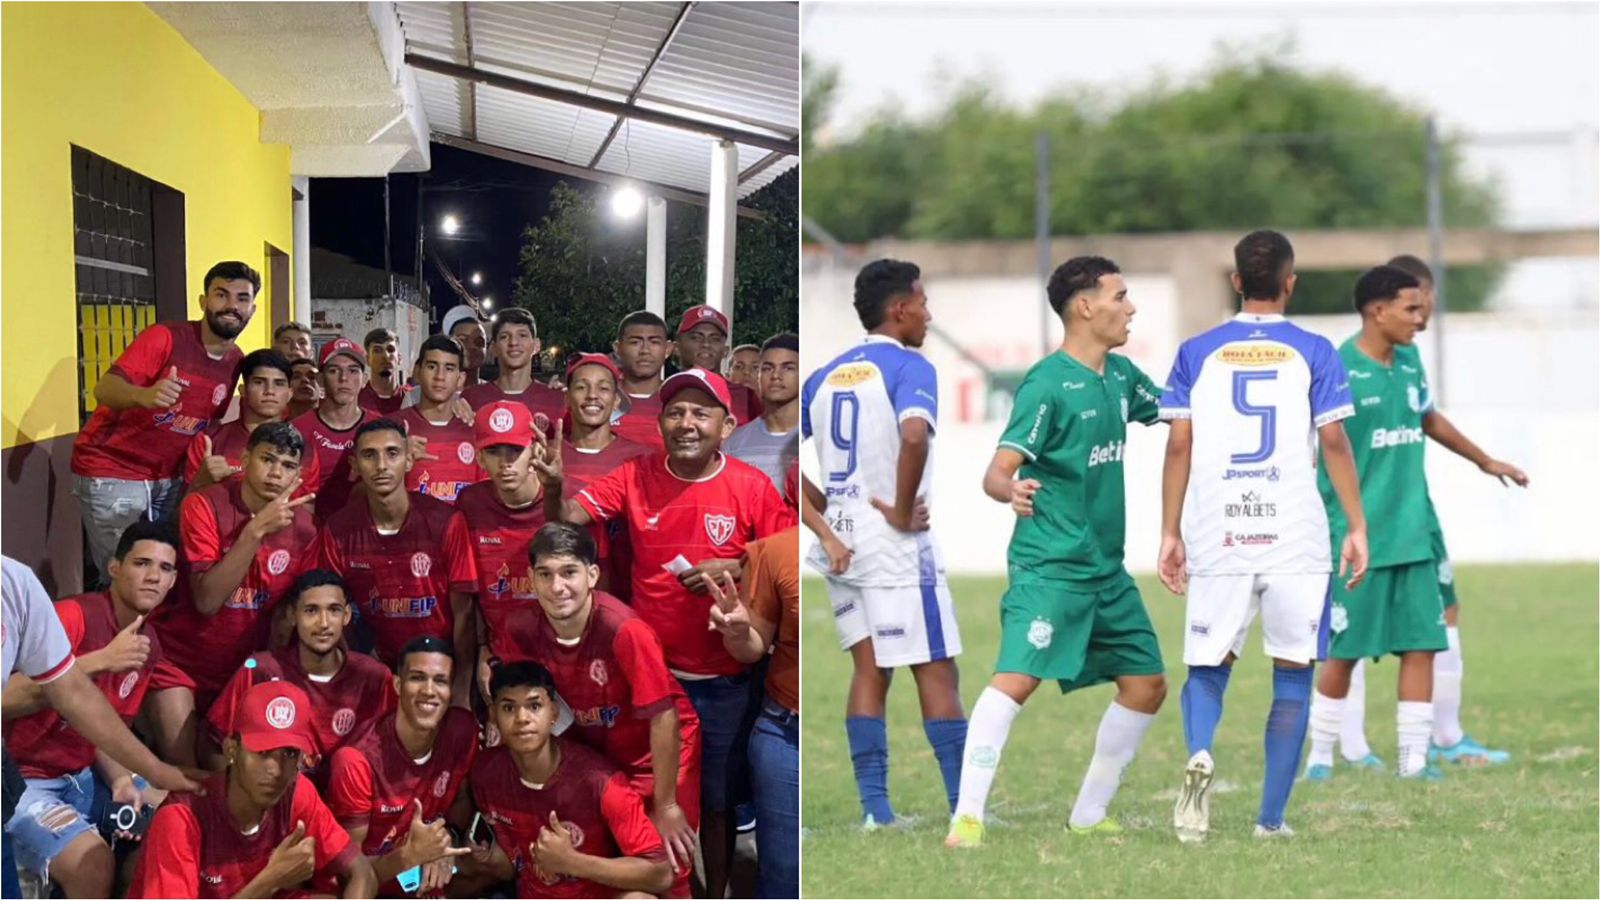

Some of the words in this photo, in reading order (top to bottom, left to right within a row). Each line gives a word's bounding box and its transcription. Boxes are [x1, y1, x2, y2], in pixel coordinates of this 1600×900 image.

[829, 390, 859, 482] 9
[1231, 370, 1278, 463] 5
[381, 595, 438, 614] UNIFIP
